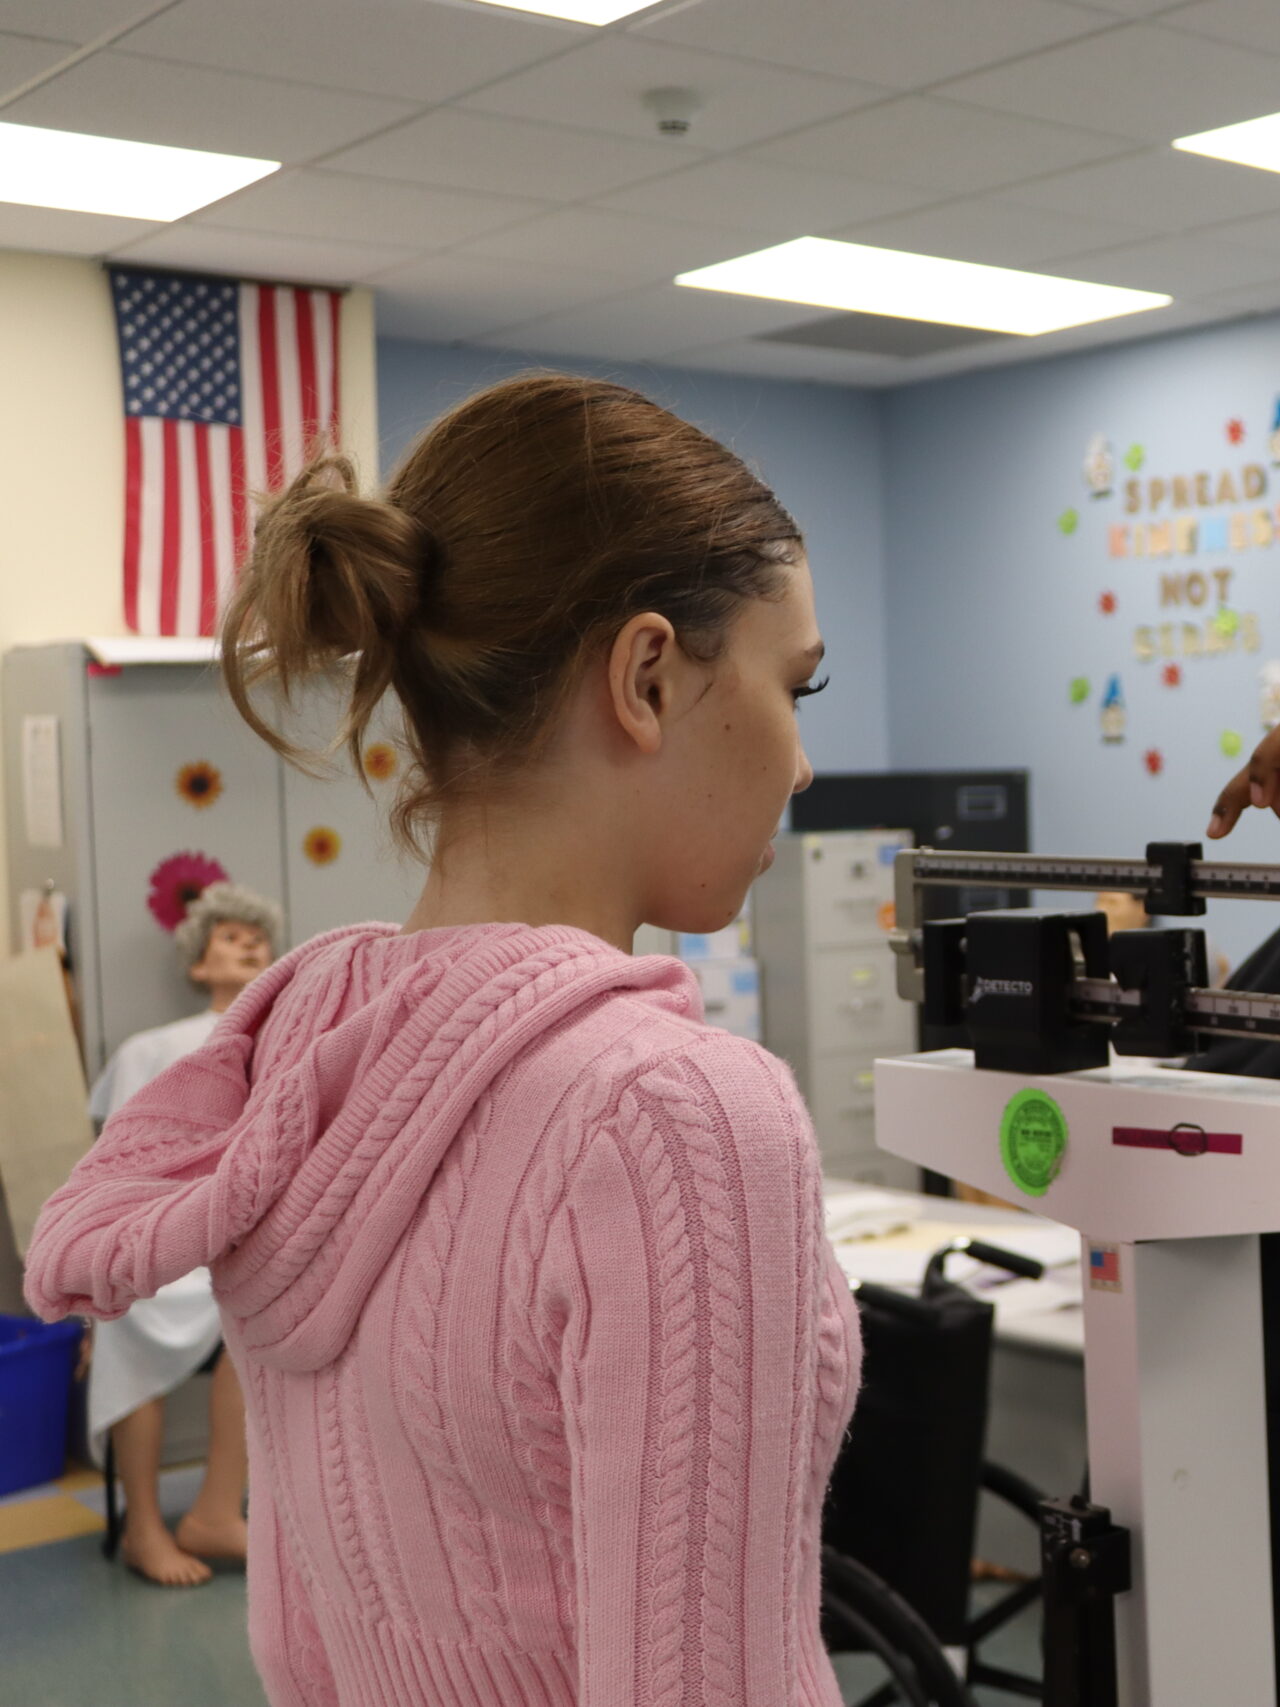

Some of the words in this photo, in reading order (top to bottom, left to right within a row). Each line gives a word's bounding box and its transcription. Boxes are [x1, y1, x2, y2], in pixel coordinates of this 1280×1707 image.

[1124, 464, 1266, 513] SPREAD
[1161, 569, 1232, 607] NOT
[984, 979, 1033, 993] DETECTO
